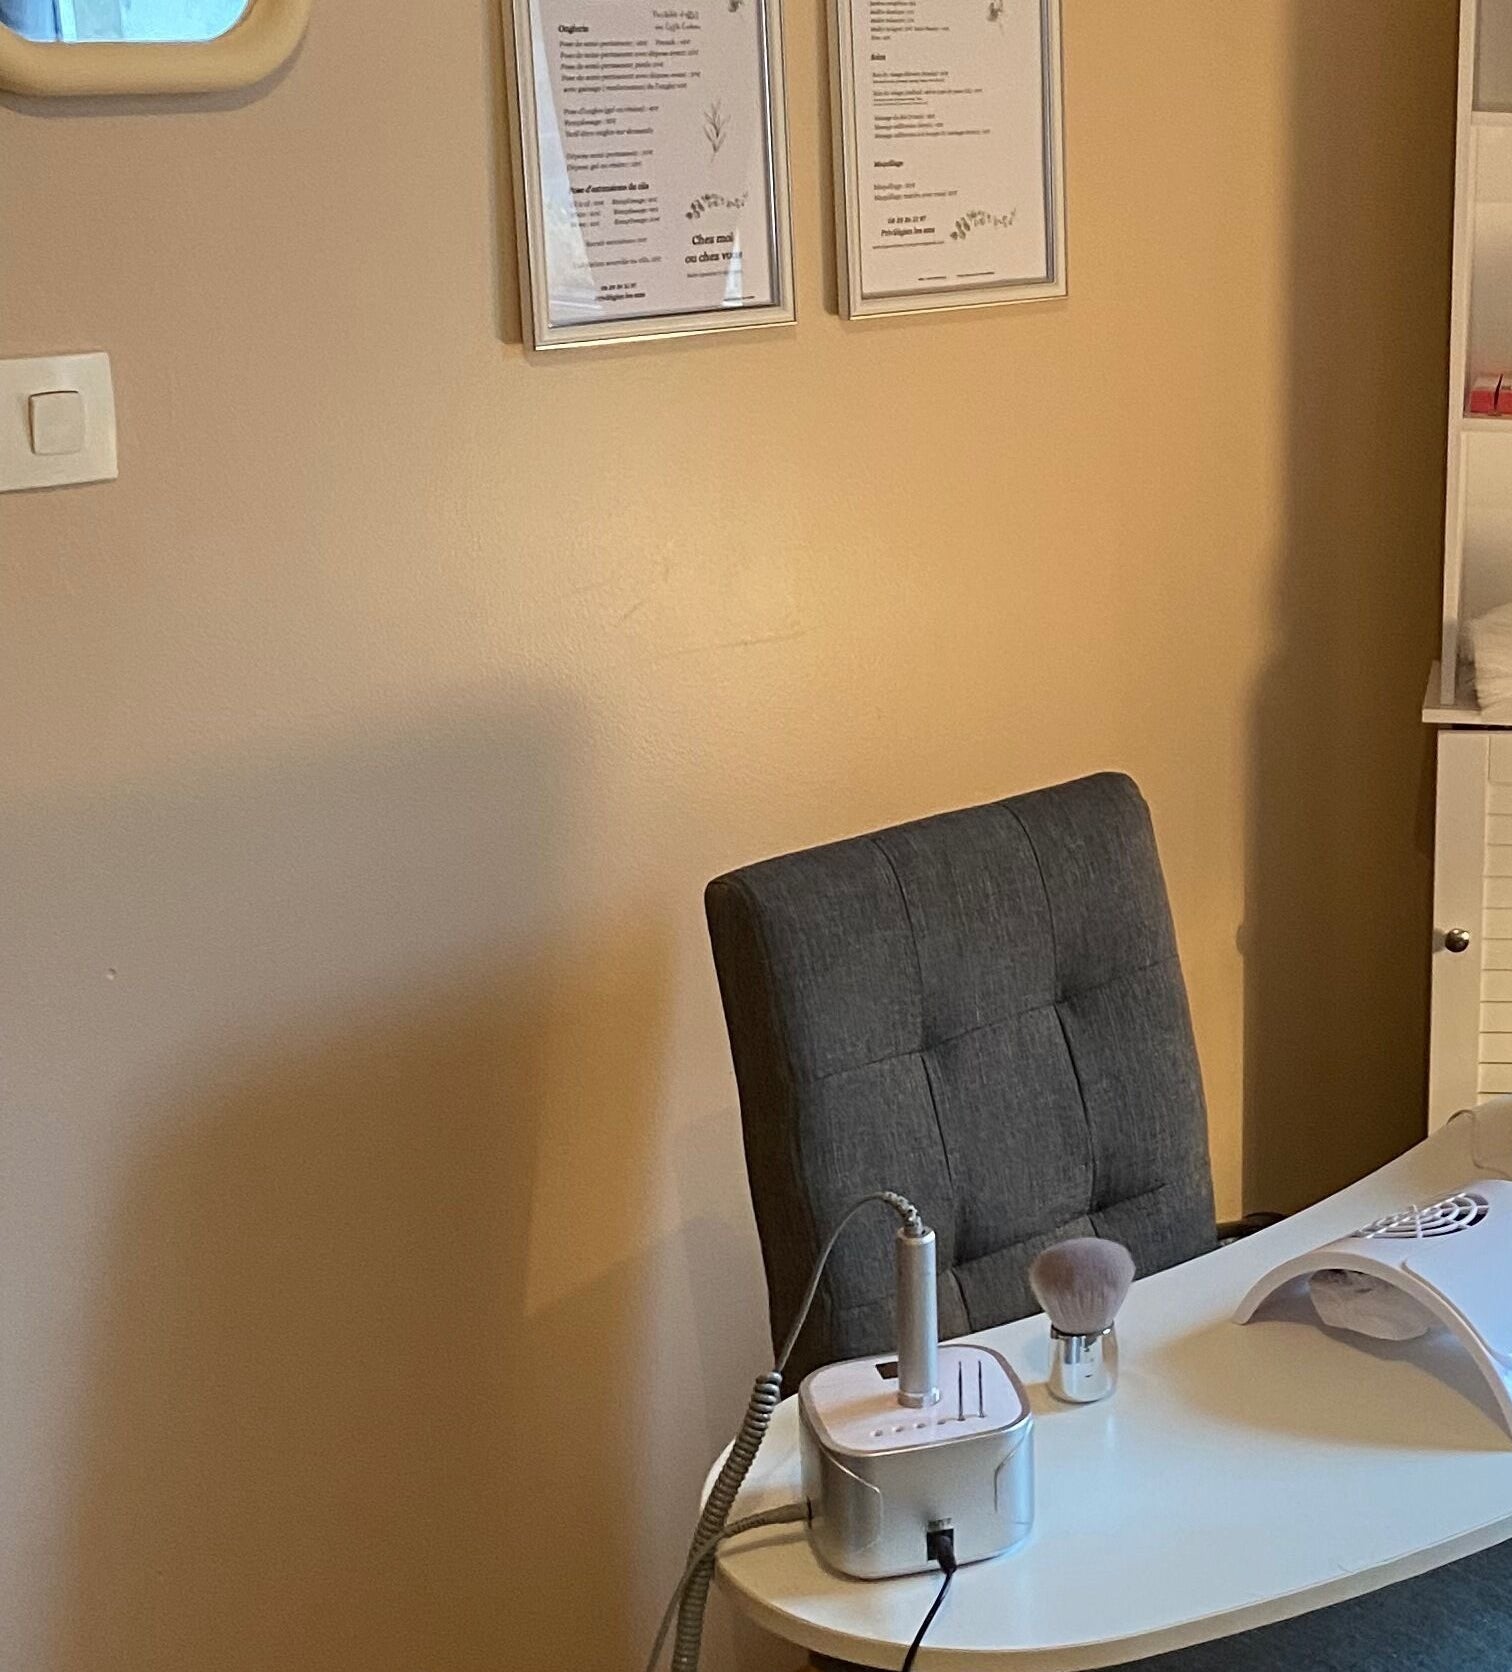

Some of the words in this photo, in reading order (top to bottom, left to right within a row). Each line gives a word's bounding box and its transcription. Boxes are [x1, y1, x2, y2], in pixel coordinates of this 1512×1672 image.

[558, 24, 589, 34] Onglerie
[692, 234, 715, 245] Chez
[716, 232, 734, 243] moi
[685, 255, 697, 264] ou
[698, 251, 720, 262] chez
